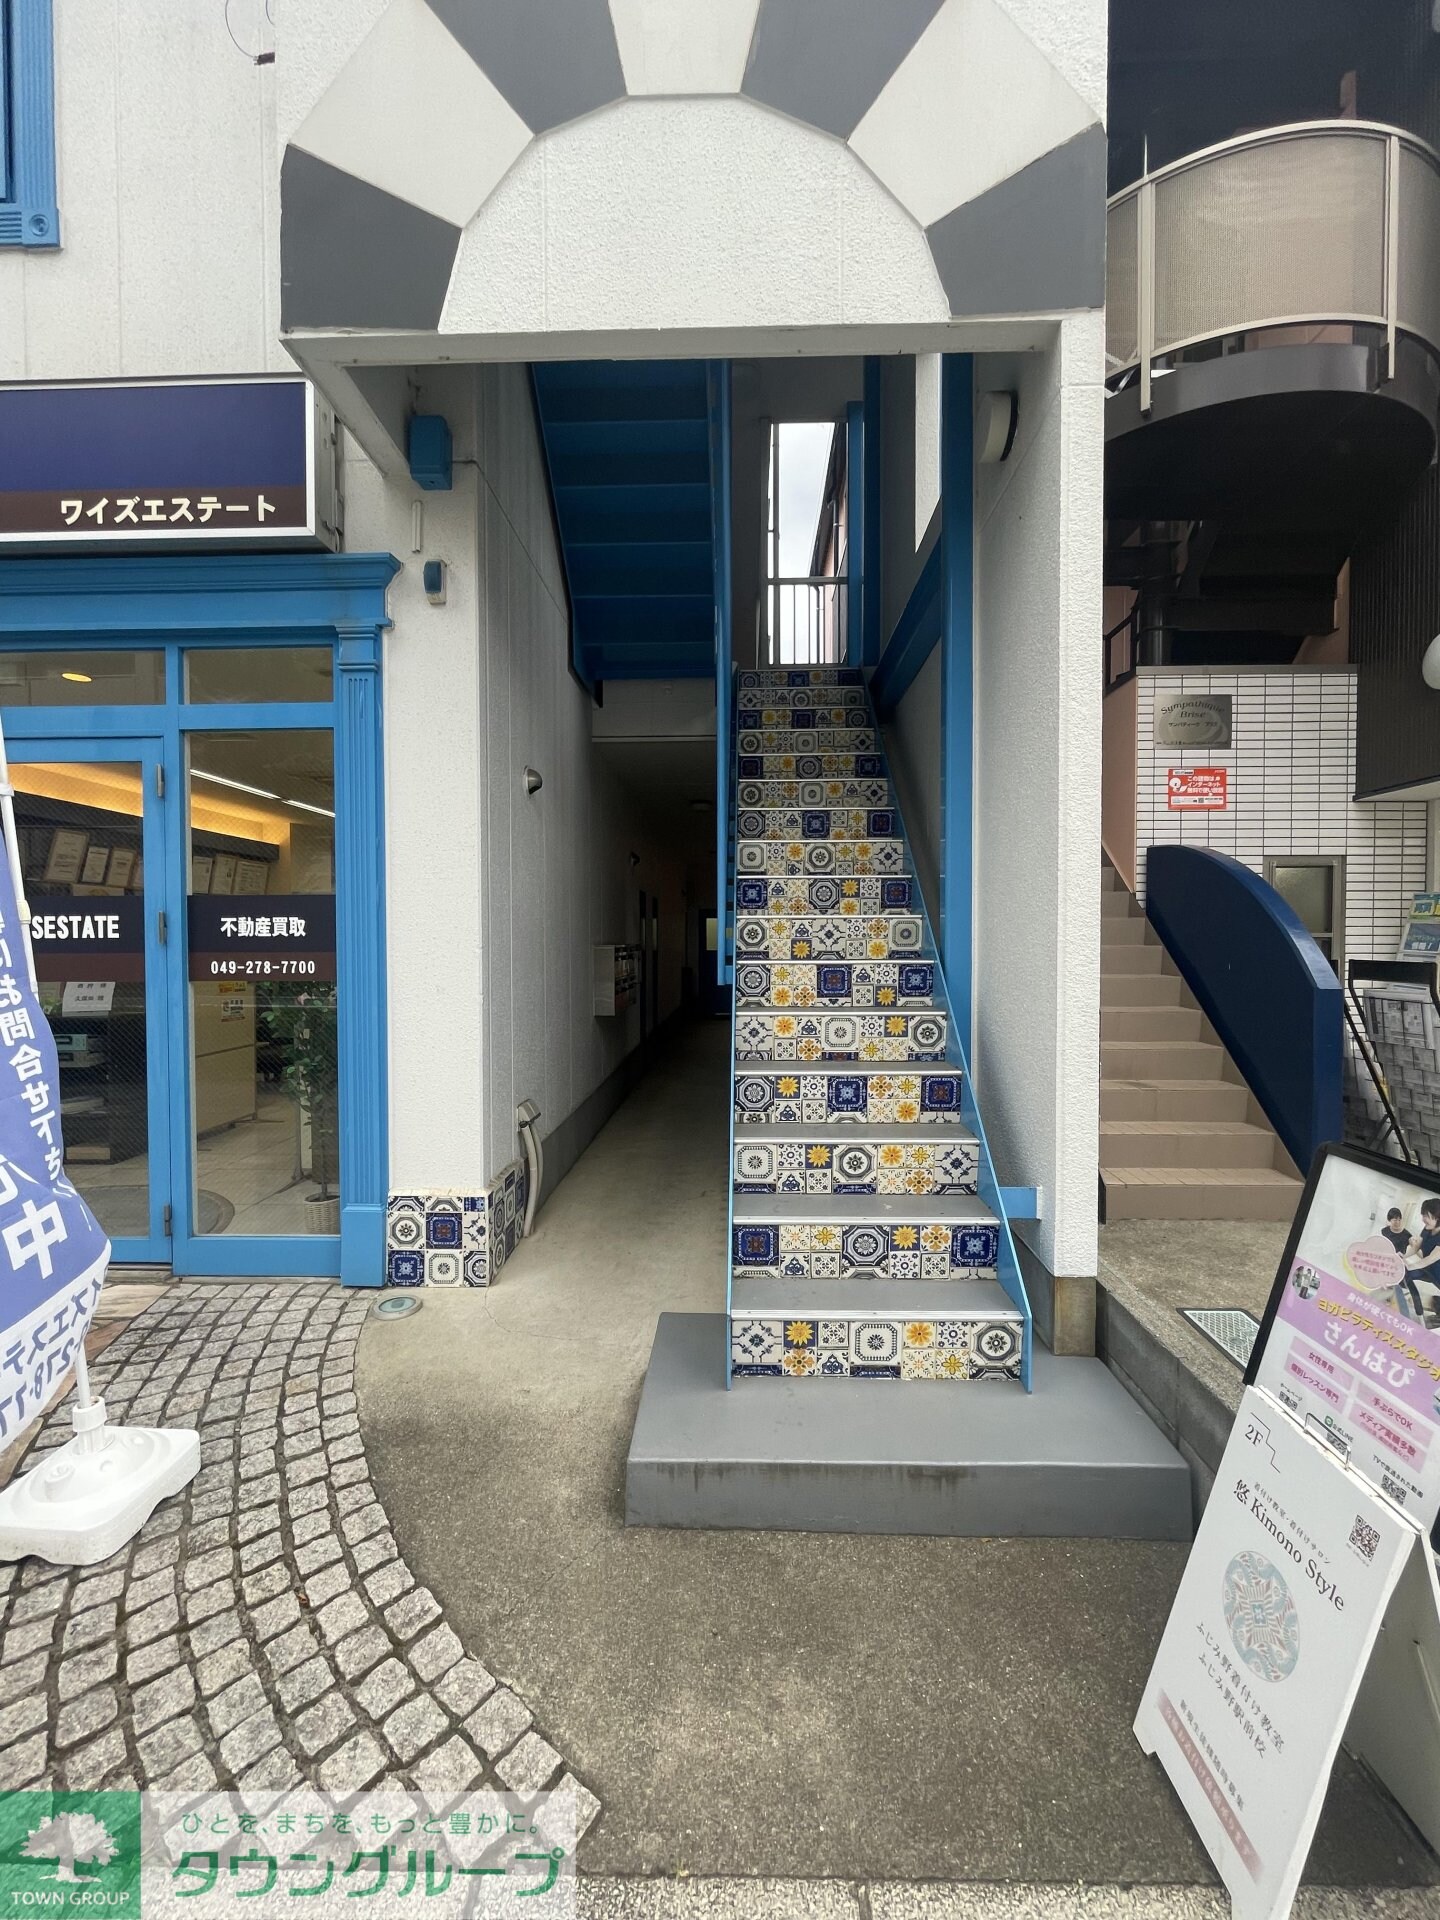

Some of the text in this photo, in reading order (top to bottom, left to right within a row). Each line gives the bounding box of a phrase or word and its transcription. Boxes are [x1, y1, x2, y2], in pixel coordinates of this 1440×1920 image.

[60, 495, 276, 525] ワイズエステート
[31, 915, 120, 940] SESTATE
[220, 916, 306, 938] 不動産買取
[210, 960, 316, 975] 049-278-7700
[1324, 1321, 1416, 1388] さんはぴ
[1373, 1397, 1414, 1431] 手ぶらでOK
[1245, 1424, 1264, 1446] 2F
[1233, 1479, 1345, 1611] 悠 Kimono Style
